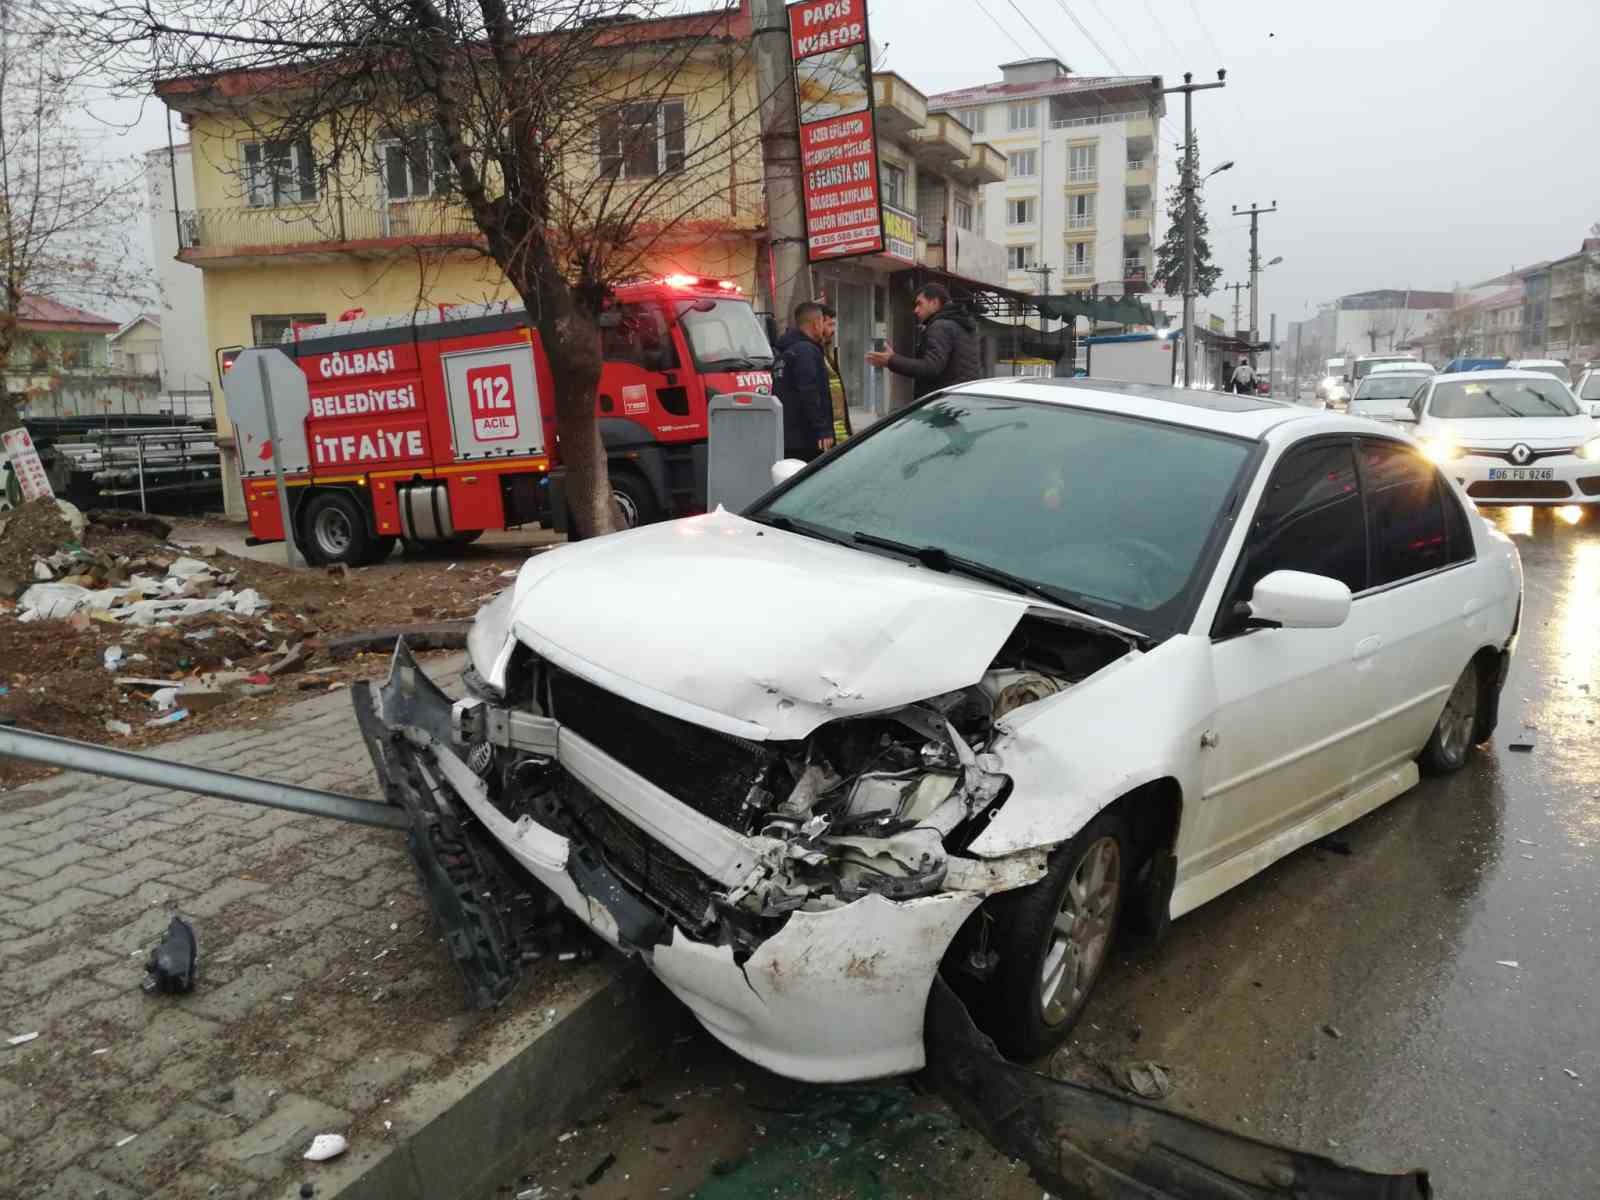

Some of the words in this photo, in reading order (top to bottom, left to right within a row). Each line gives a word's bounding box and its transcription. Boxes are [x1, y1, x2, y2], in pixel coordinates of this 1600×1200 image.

[816, 162, 851, 188] SEANSTA
[853, 160, 870, 181] SON
[320, 350, 395, 378] GÖLBAŞI
[312, 384, 416, 417] BELEDİYESİ
[473, 376, 511, 409] 112
[314, 429, 425, 464] İTFAİYE
[1496, 471, 1507, 480] 06
